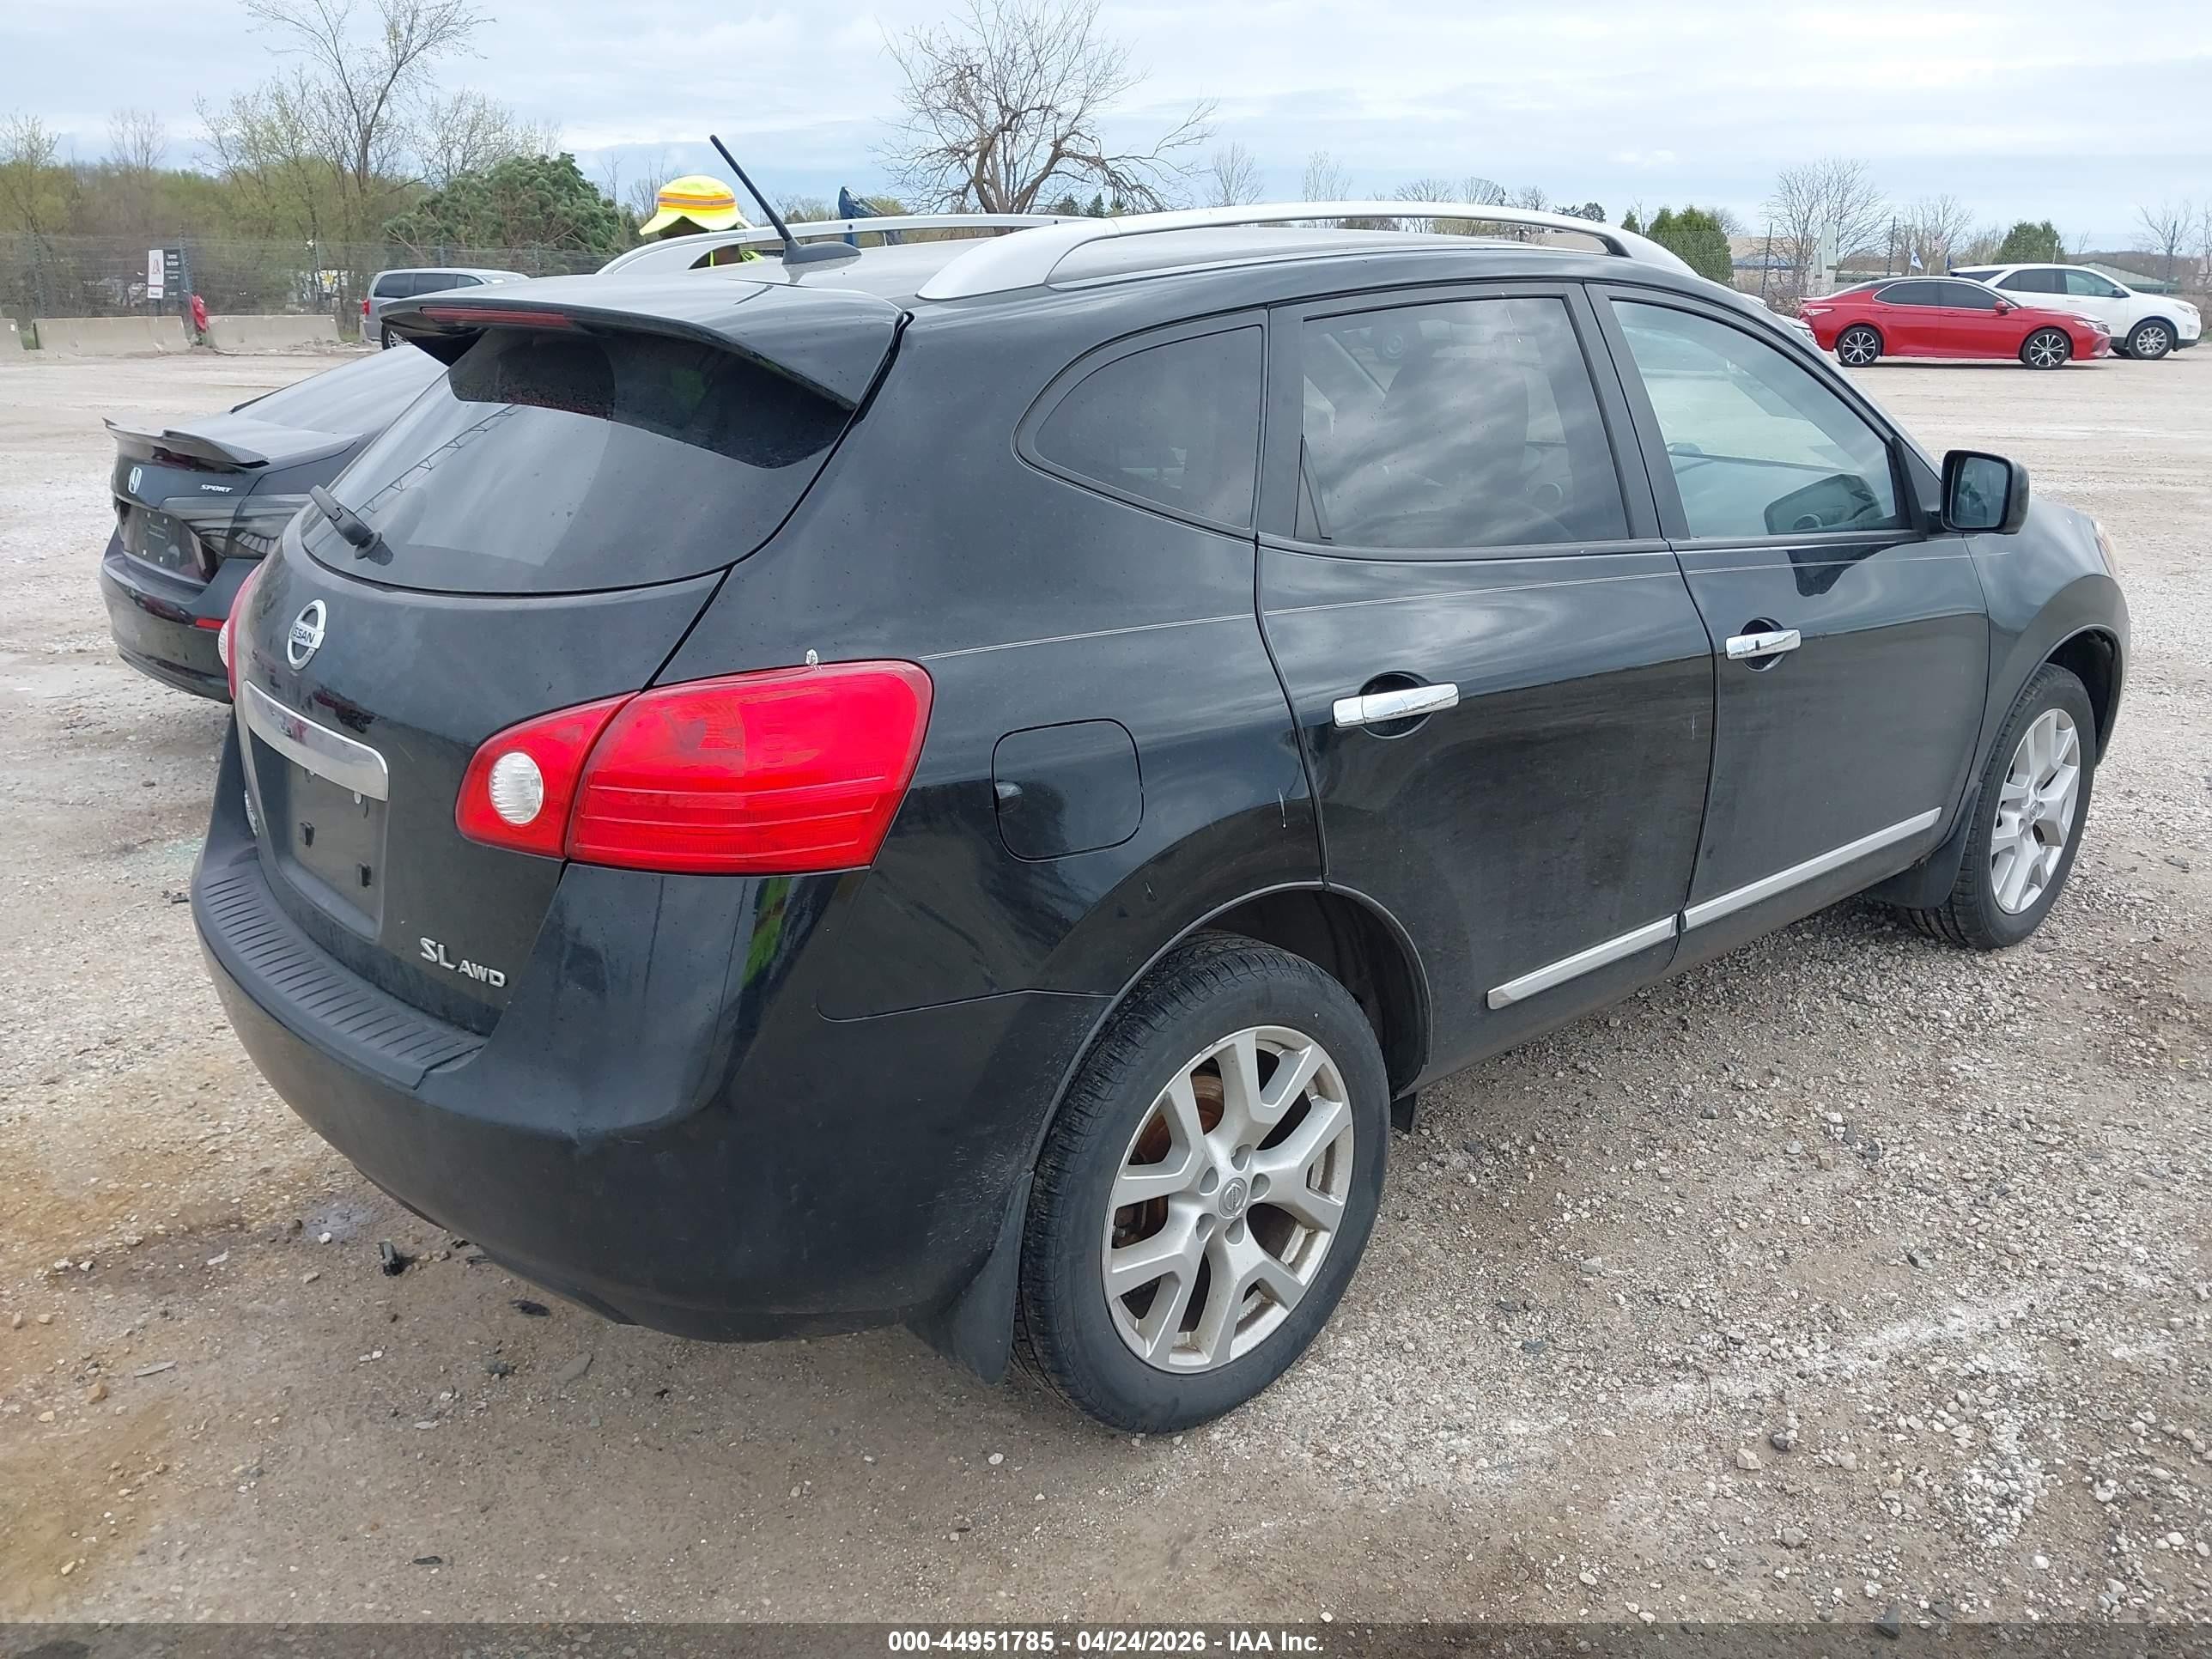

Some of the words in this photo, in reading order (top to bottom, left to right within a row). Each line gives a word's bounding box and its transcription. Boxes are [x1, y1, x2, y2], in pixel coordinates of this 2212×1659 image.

[199, 483, 234, 493] SPORT
[420, 937, 456, 970] SL
[458, 959, 506, 988] AWD
